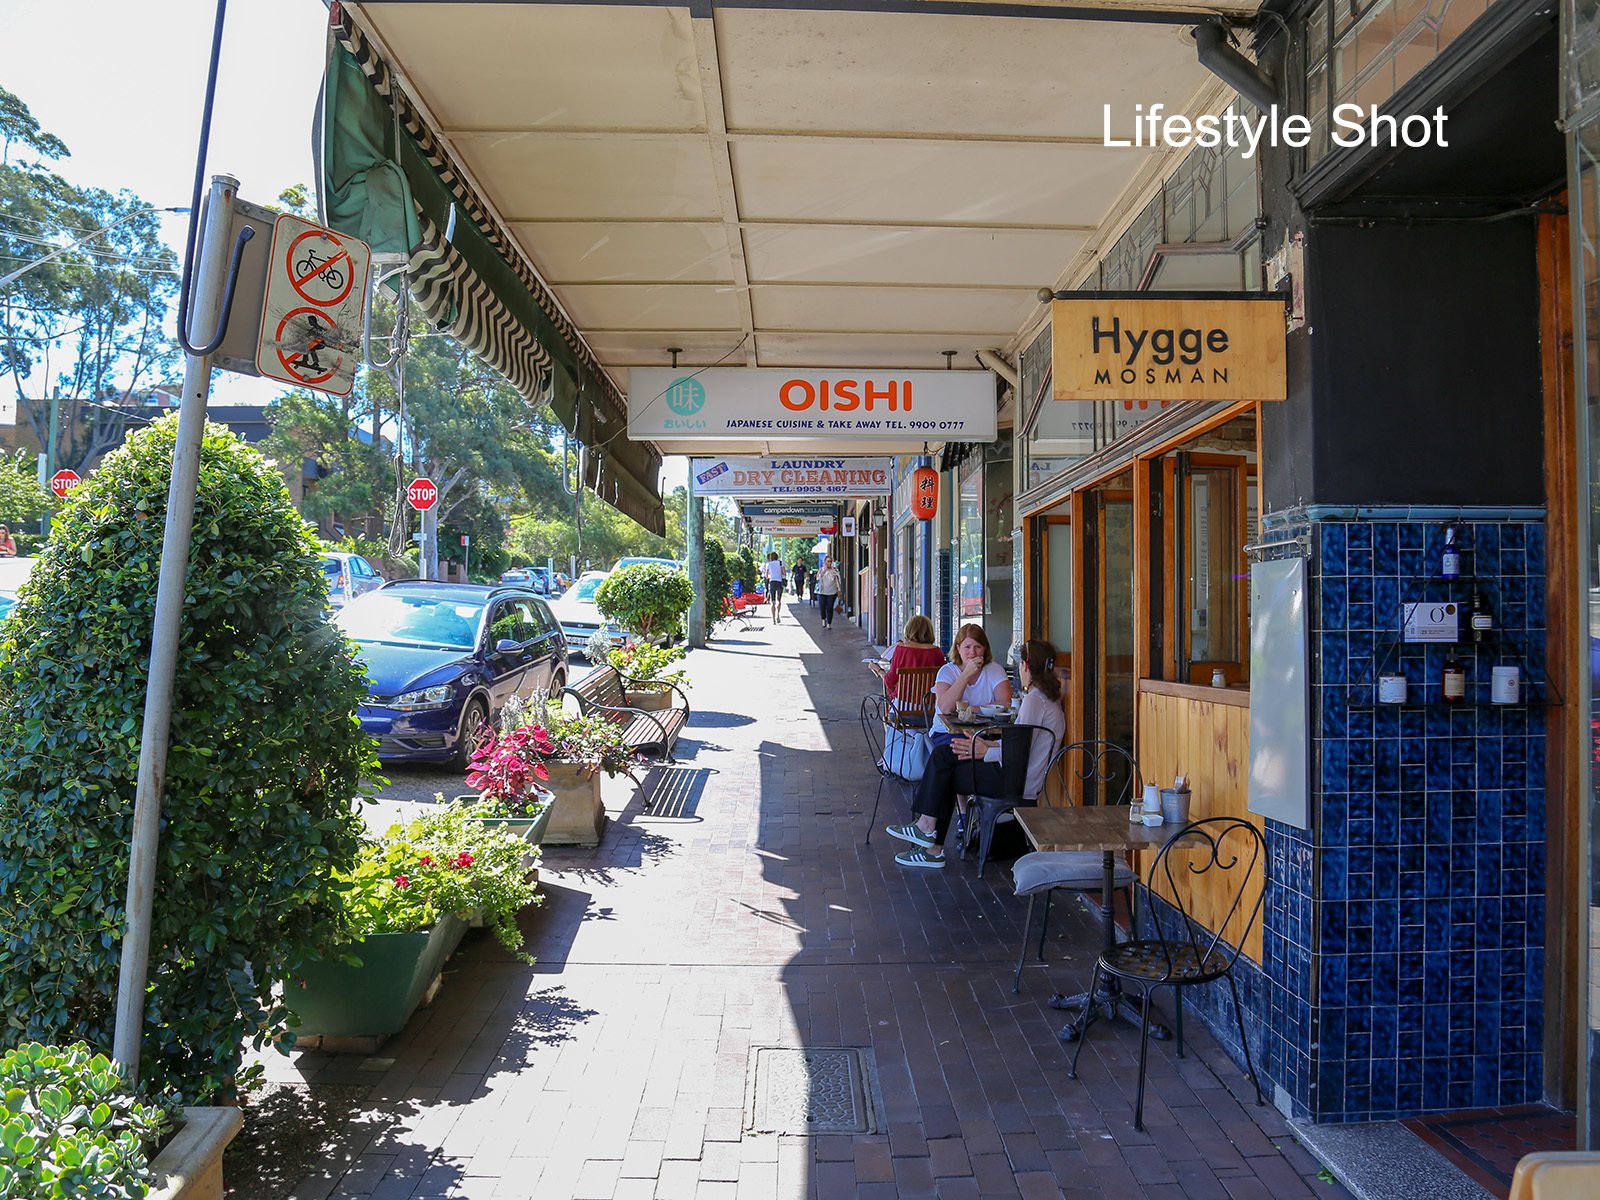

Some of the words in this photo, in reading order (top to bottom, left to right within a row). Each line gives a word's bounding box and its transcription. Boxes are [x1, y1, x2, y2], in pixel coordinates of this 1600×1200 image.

[1092, 316, 1229, 365] Hygge
[1094, 368, 1229, 384] MOSMAN
[672, 382, 700, 411] 味
[779, 379, 913, 412] OISHI
[663, 419, 706, 429] おいしい
[726, 420, 773, 429] JAPANESE
[776, 420, 813, 429] CUISINE
[816, 420, 825, 429] &
[828, 420, 852, 429] TAKE
[855, 420, 882, 429] AWAY
[885, 420, 907, 429] TEL.
[909, 420, 936, 430] 9909
[939, 420, 965, 430] 0777
[771, 460, 846, 469] LAUNDRY
[698, 463, 728, 484] FAST
[733, 470, 775, 486] DRY
[781, 469, 887, 486] CLEANING
[53, 478, 79, 490] STOP
[409, 488, 436, 500] STOP
